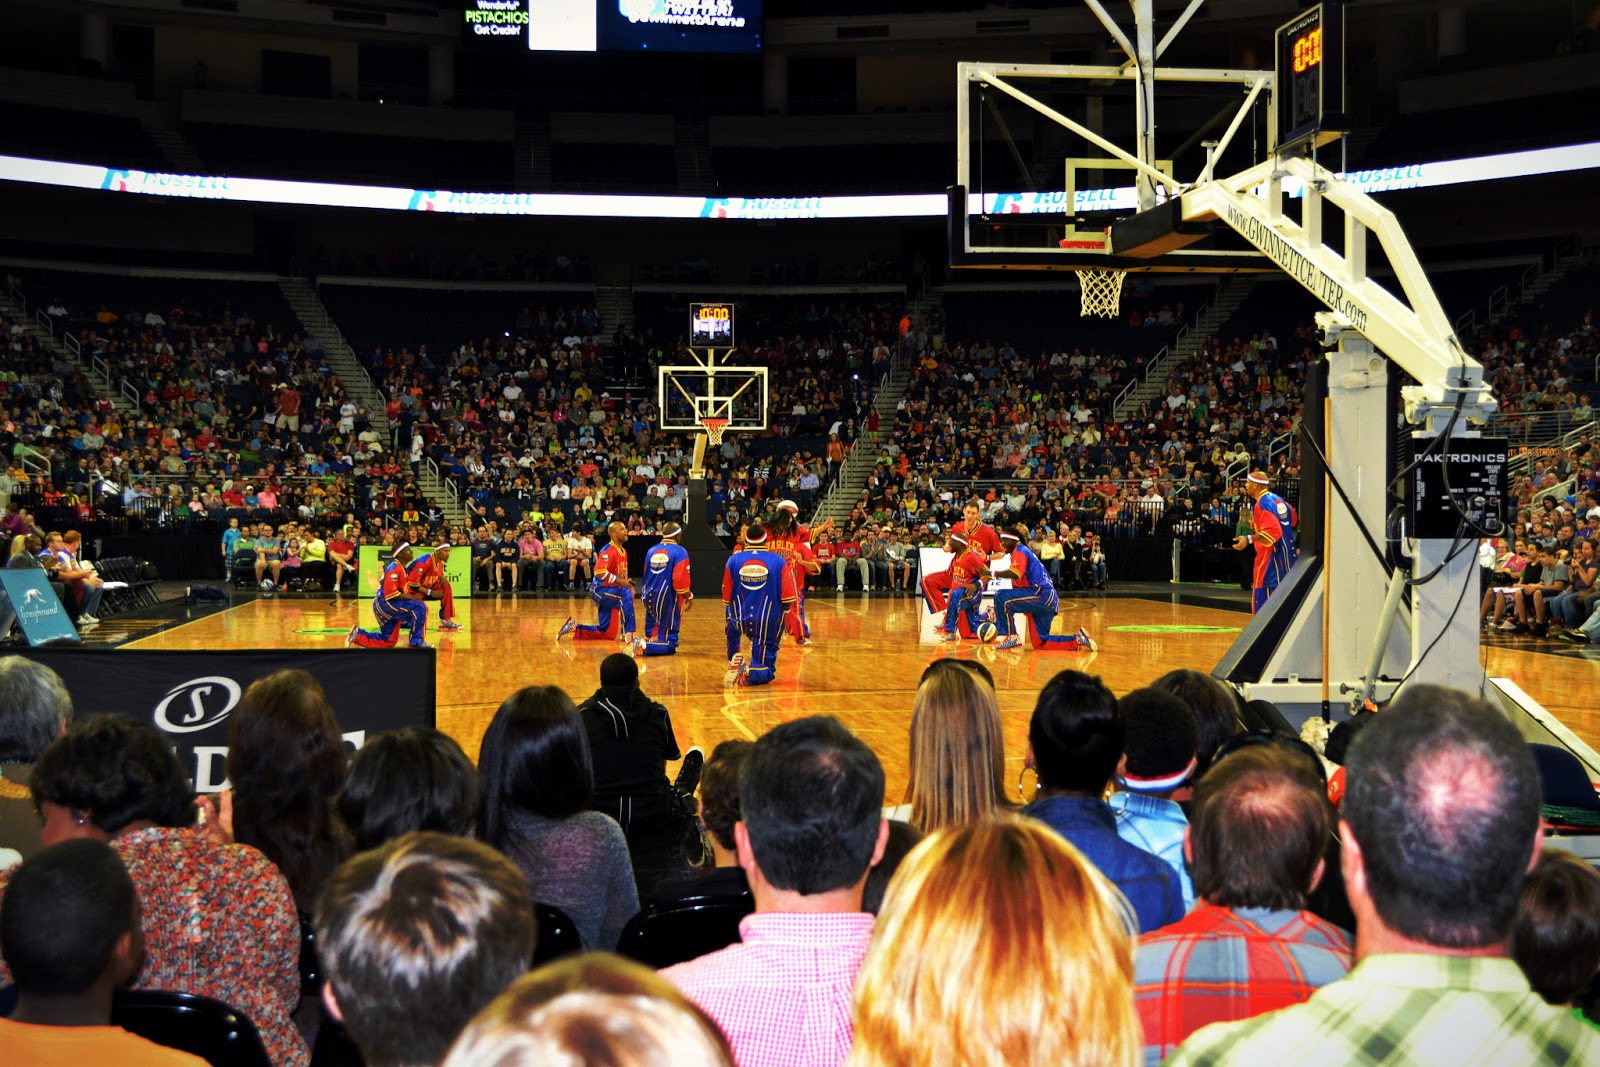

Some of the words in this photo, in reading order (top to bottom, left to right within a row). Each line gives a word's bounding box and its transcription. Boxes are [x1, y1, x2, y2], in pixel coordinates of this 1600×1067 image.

[465, 10, 529, 24] PISTACHIOS
[1034, 189, 1118, 204] RUSELL
[699, 307, 729, 320] 10:00
[20, 600, 58, 625] Greyhound
